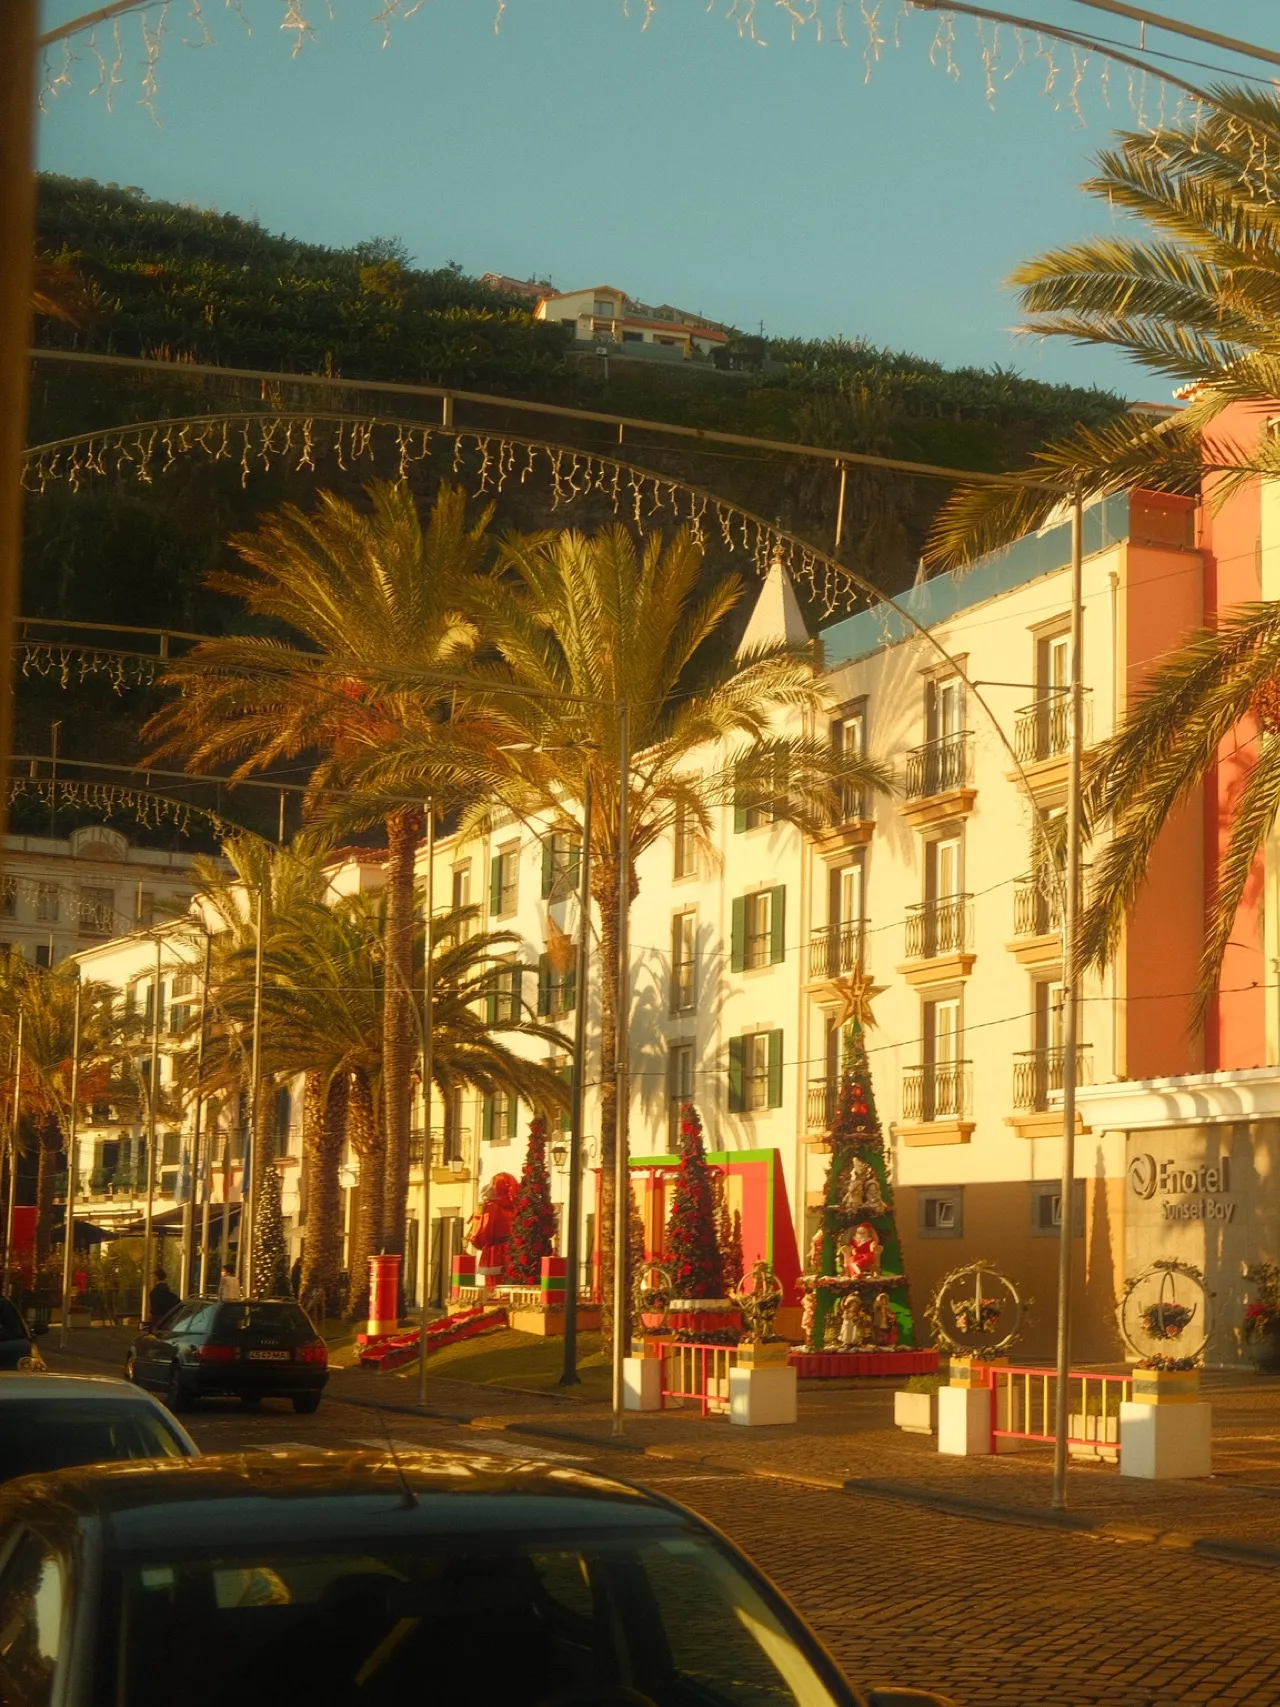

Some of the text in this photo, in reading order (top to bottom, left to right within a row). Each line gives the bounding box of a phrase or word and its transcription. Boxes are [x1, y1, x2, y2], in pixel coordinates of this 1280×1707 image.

[1160, 1156, 1230, 1194] Enotel
[1162, 1199, 1235, 1223] Sunset Bay
